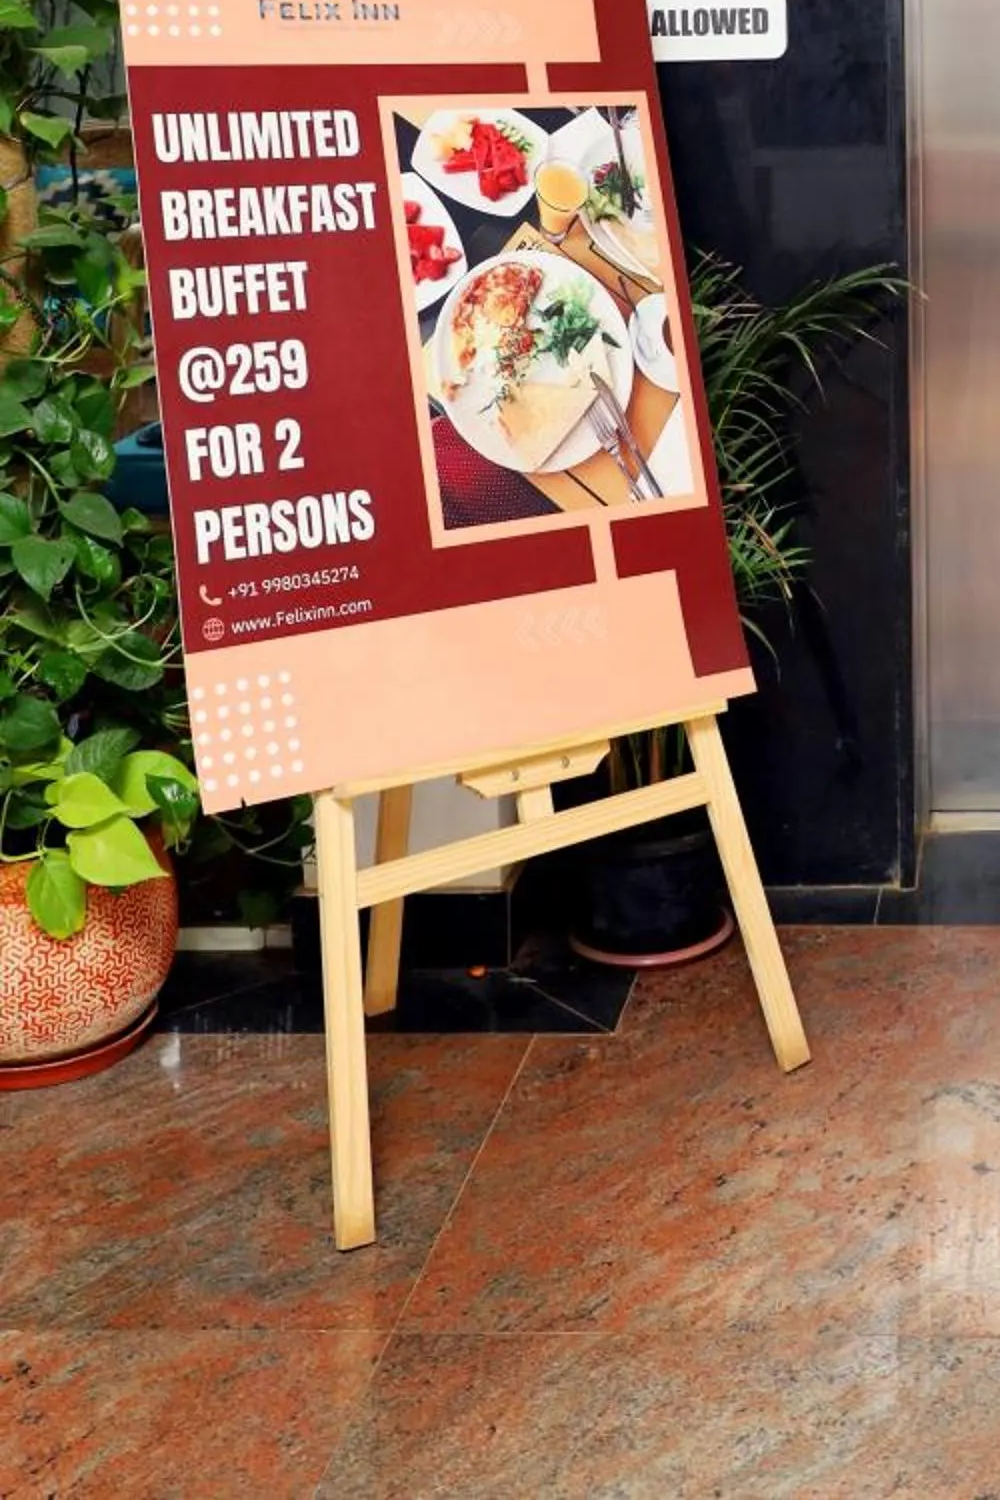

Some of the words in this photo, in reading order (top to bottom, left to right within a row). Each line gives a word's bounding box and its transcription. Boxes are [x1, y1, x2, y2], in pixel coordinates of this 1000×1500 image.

[651, 8, 769, 37] ALLOWED
[152, 110, 360, 163] UNLIMITED
[160, 182, 377, 241] BREAKFAST
[168, 261, 307, 320] BUFFET
[178, 339, 309, 403] @259
[185, 422, 265, 482] FOR
[275, 417, 305, 471] 2
[194, 489, 375, 564] PERSONS
[228, 582, 259, 598] +91
[261, 565, 359, 594] 9980345274
[231, 599, 372, 635] www.Felixinn.com
